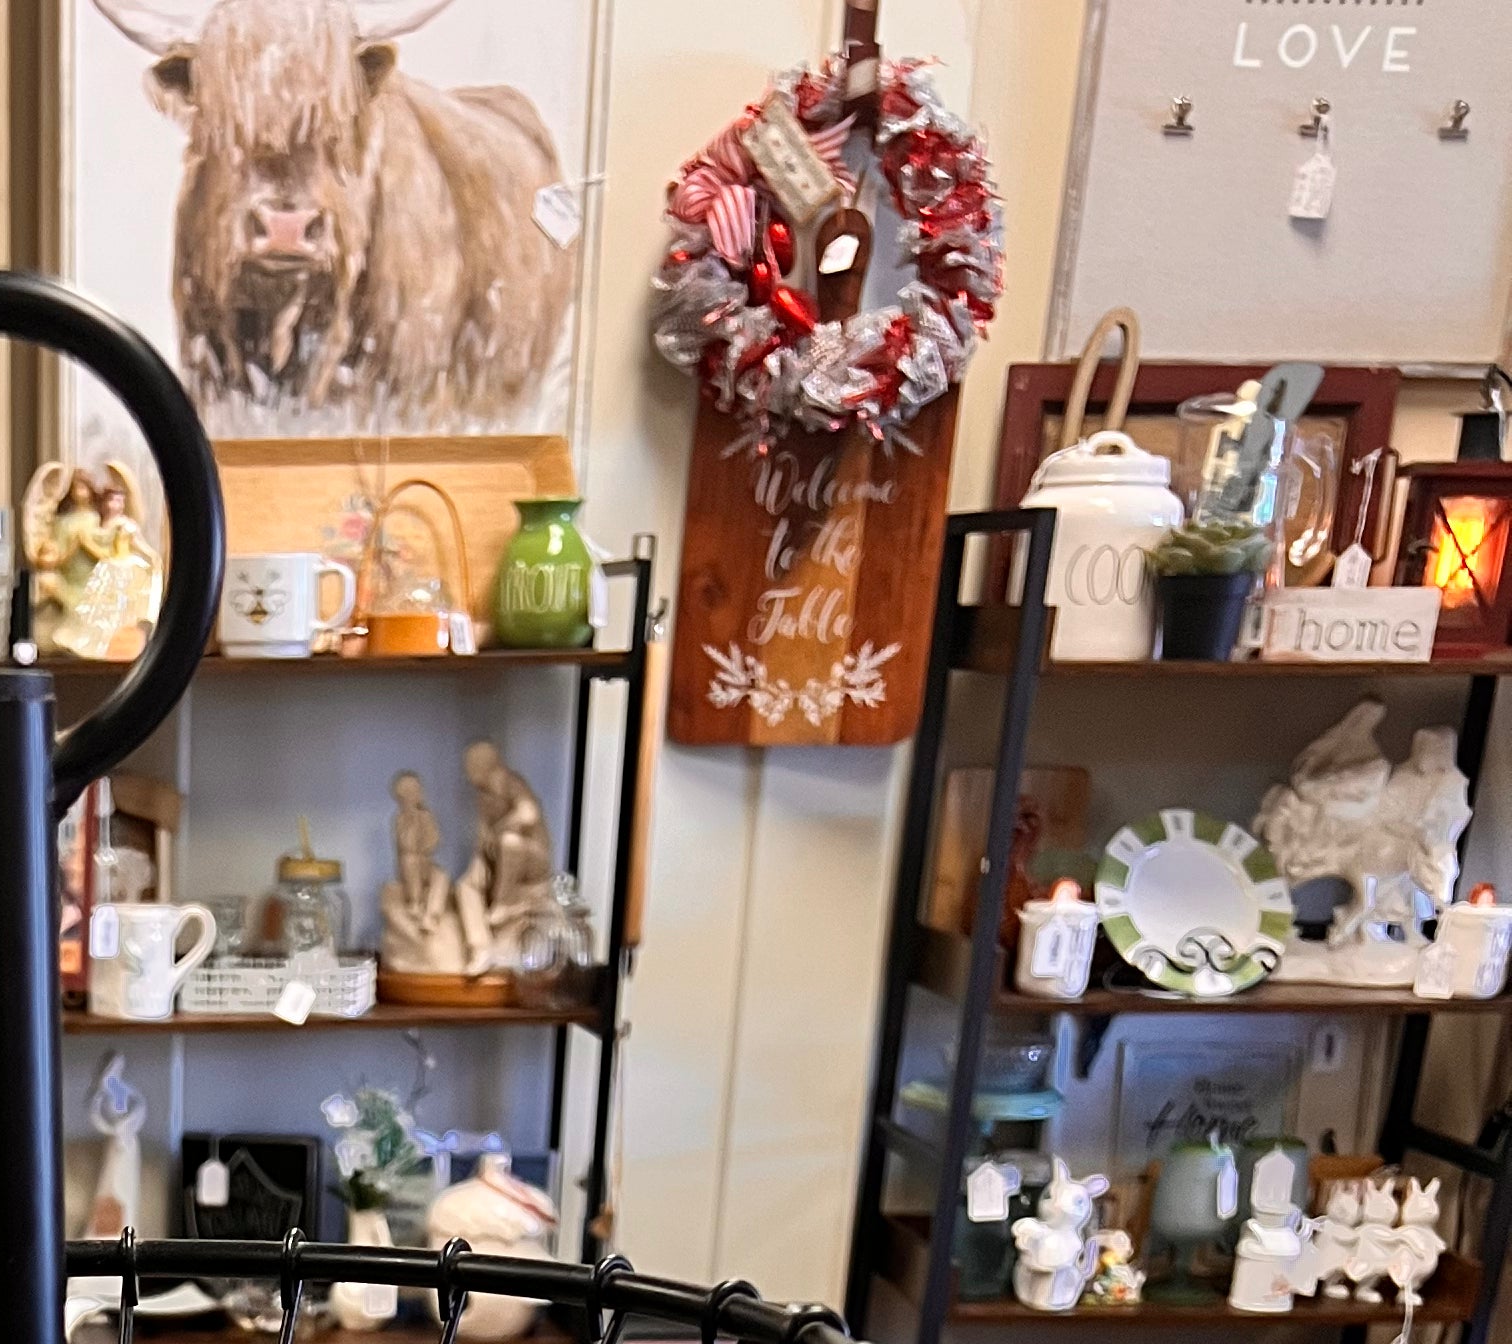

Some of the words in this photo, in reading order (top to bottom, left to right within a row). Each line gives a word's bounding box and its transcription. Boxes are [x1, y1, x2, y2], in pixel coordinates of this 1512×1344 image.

[1232, 21, 1418, 73] LOVE
[753, 451, 898, 516] Welcome
[759, 517, 797, 582] to
[803, 515, 861, 577] the
[1064, 543, 1148, 606] COO
[746, 584, 853, 646] Table
[1294, 605, 1422, 652] home
